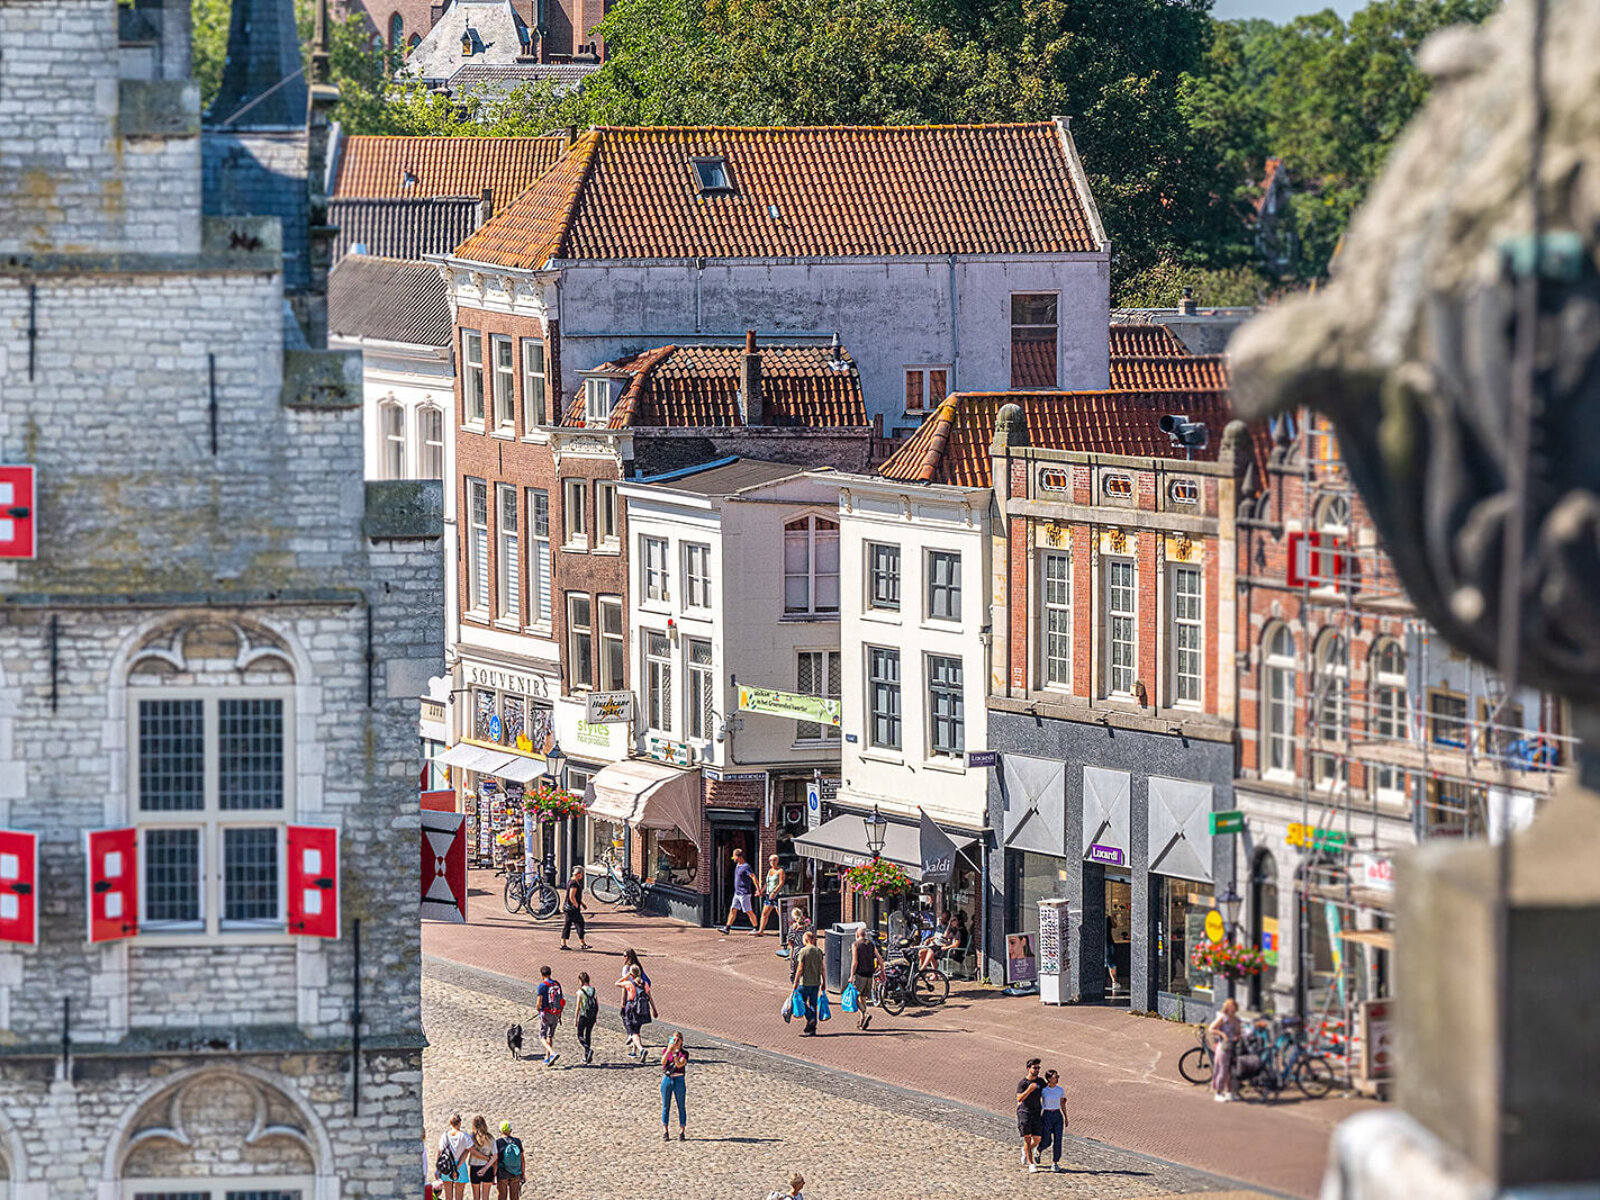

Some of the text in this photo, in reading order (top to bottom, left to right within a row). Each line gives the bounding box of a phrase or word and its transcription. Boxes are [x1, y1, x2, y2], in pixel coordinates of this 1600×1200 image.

[472, 667, 549, 698] SOUVENIRS
[592, 699, 630, 708] Hurricane
[596, 708, 625, 717] Jackets
[577, 719, 610, 736] styles
[1092, 847, 1119, 861] Lucardi
[925, 857, 950, 872] kaldi
